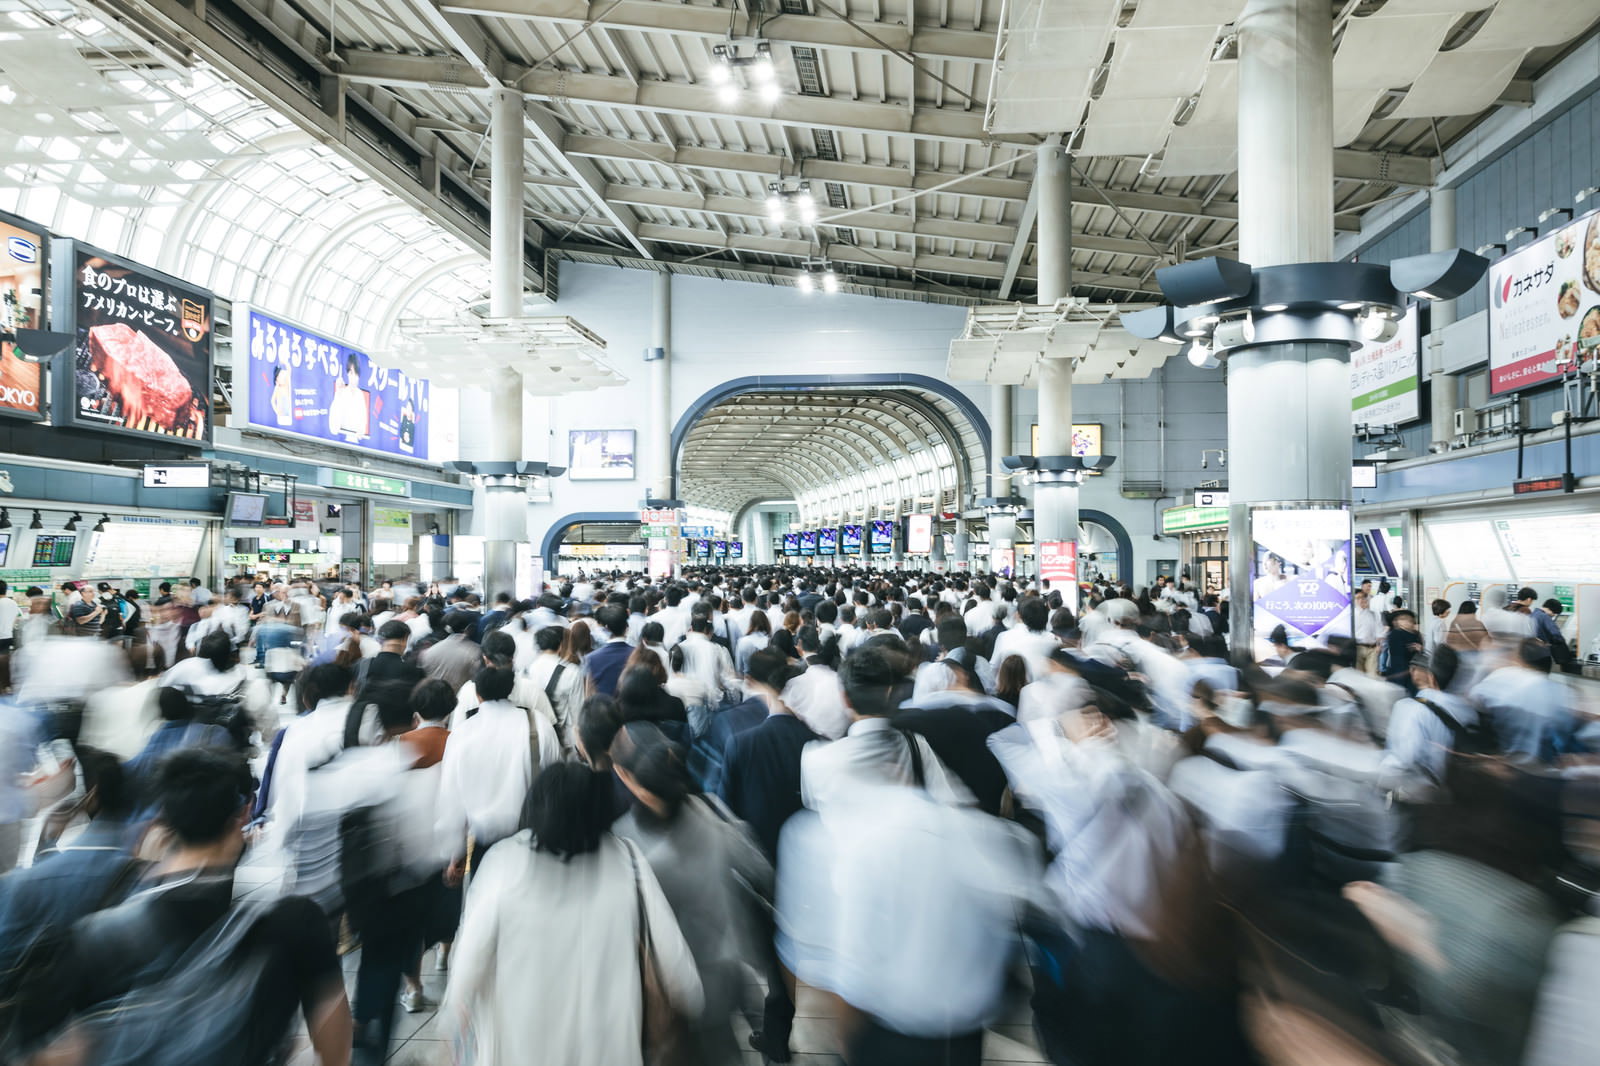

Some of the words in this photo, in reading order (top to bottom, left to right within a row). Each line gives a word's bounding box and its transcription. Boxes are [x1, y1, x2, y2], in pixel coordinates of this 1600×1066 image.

[81, 265, 178, 312] 食のプロは選ぶ
[1513, 261, 1555, 298] カネサダ
[82, 292, 179, 337] アメリカン・ビーフ。
